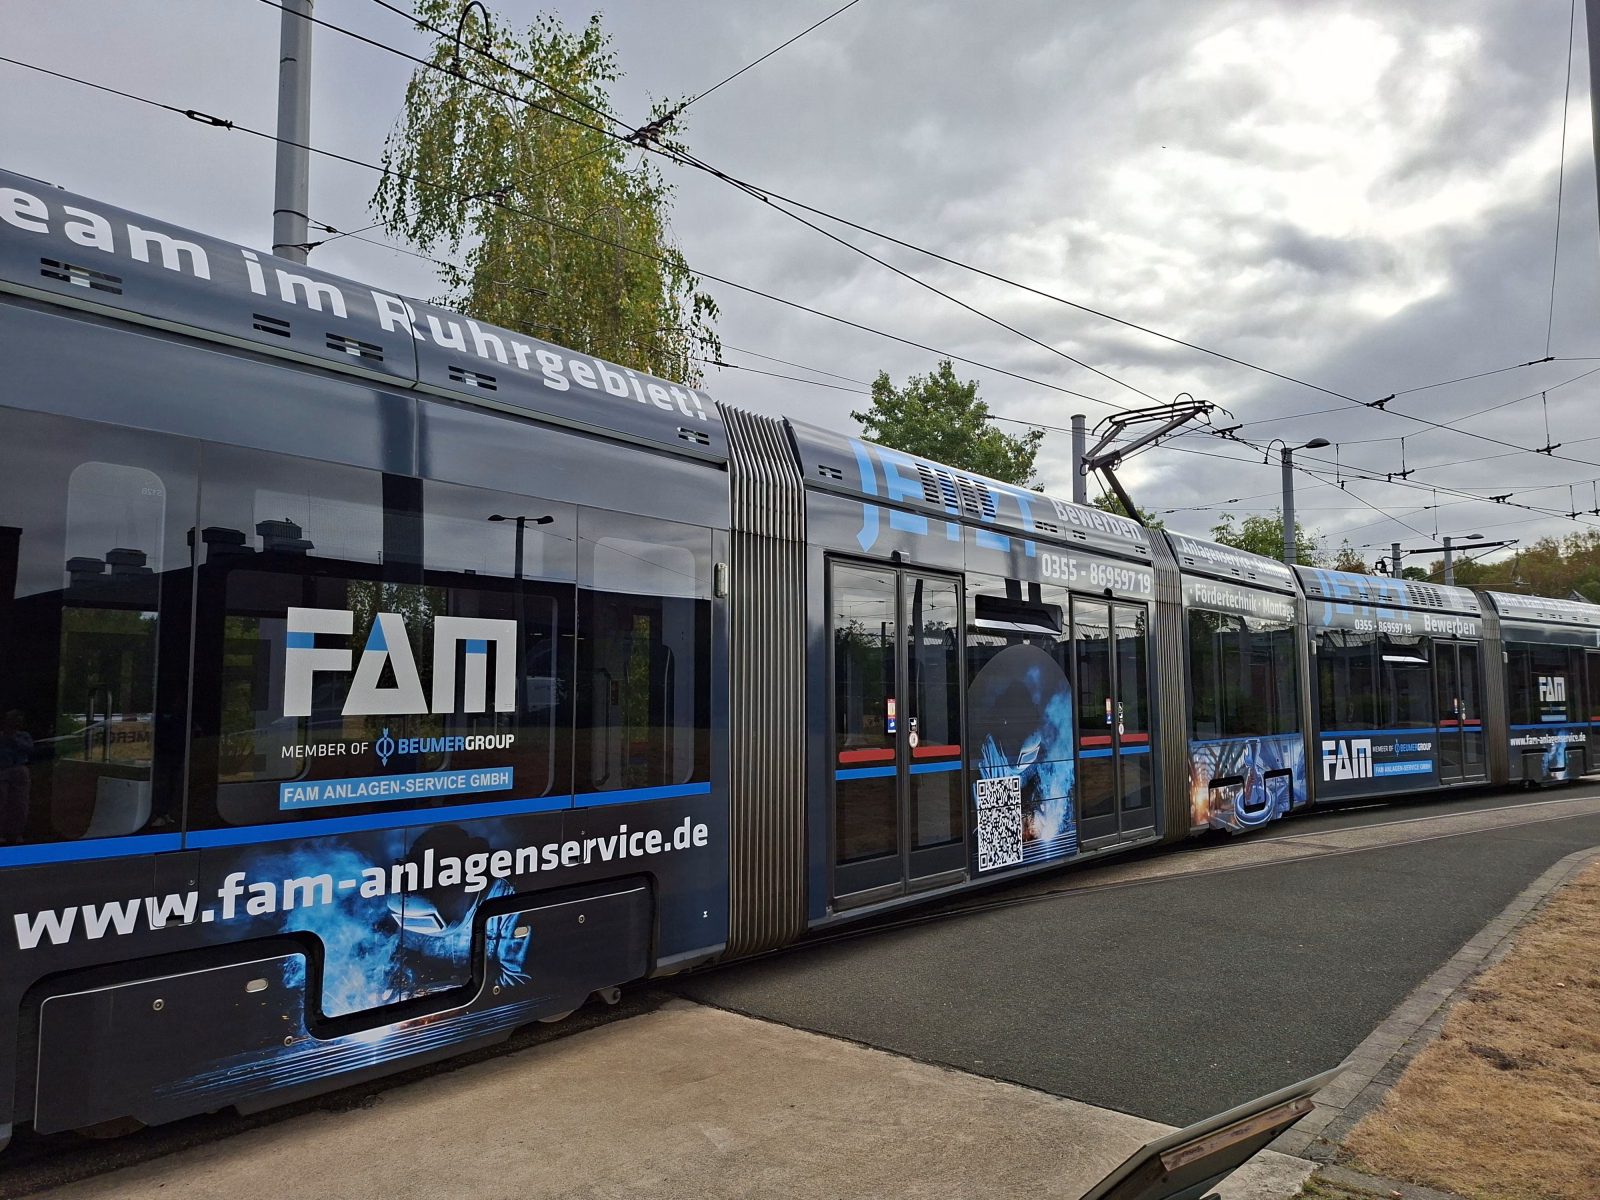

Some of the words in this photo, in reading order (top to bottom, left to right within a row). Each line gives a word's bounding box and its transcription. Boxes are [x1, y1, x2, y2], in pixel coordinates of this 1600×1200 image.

[241, 248, 348, 320] im
[371, 287, 708, 422] Ruhrgebiet!
[848, 438, 1036, 558] JETZT
[1049, 498, 1142, 541] Bewerben
[1041, 553, 1077, 581] 0355
[1180, 538, 1252, 570] Anlagenservice
[1195, 583, 1257, 612] Fördertechnik
[1262, 596, 1295, 622] Montage
[1312, 569, 1408, 627] JETZT
[1354, 618, 1373, 631] 0355
[1423, 614, 1476, 636] Bewerben
[283, 606, 518, 717] FAM
[1538, 676, 1566, 702] FAM
[281, 743, 346, 759] MEMBER
[350, 742, 369, 755] OF
[1321, 739, 1373, 782] FAM
[283, 785, 319, 804] FAM
[323, 774, 466, 800] ANLAGEN-SERVICE
[470, 771, 509, 788] GMBH
[13, 815, 710, 951] www.fam-anlagenservice.de
